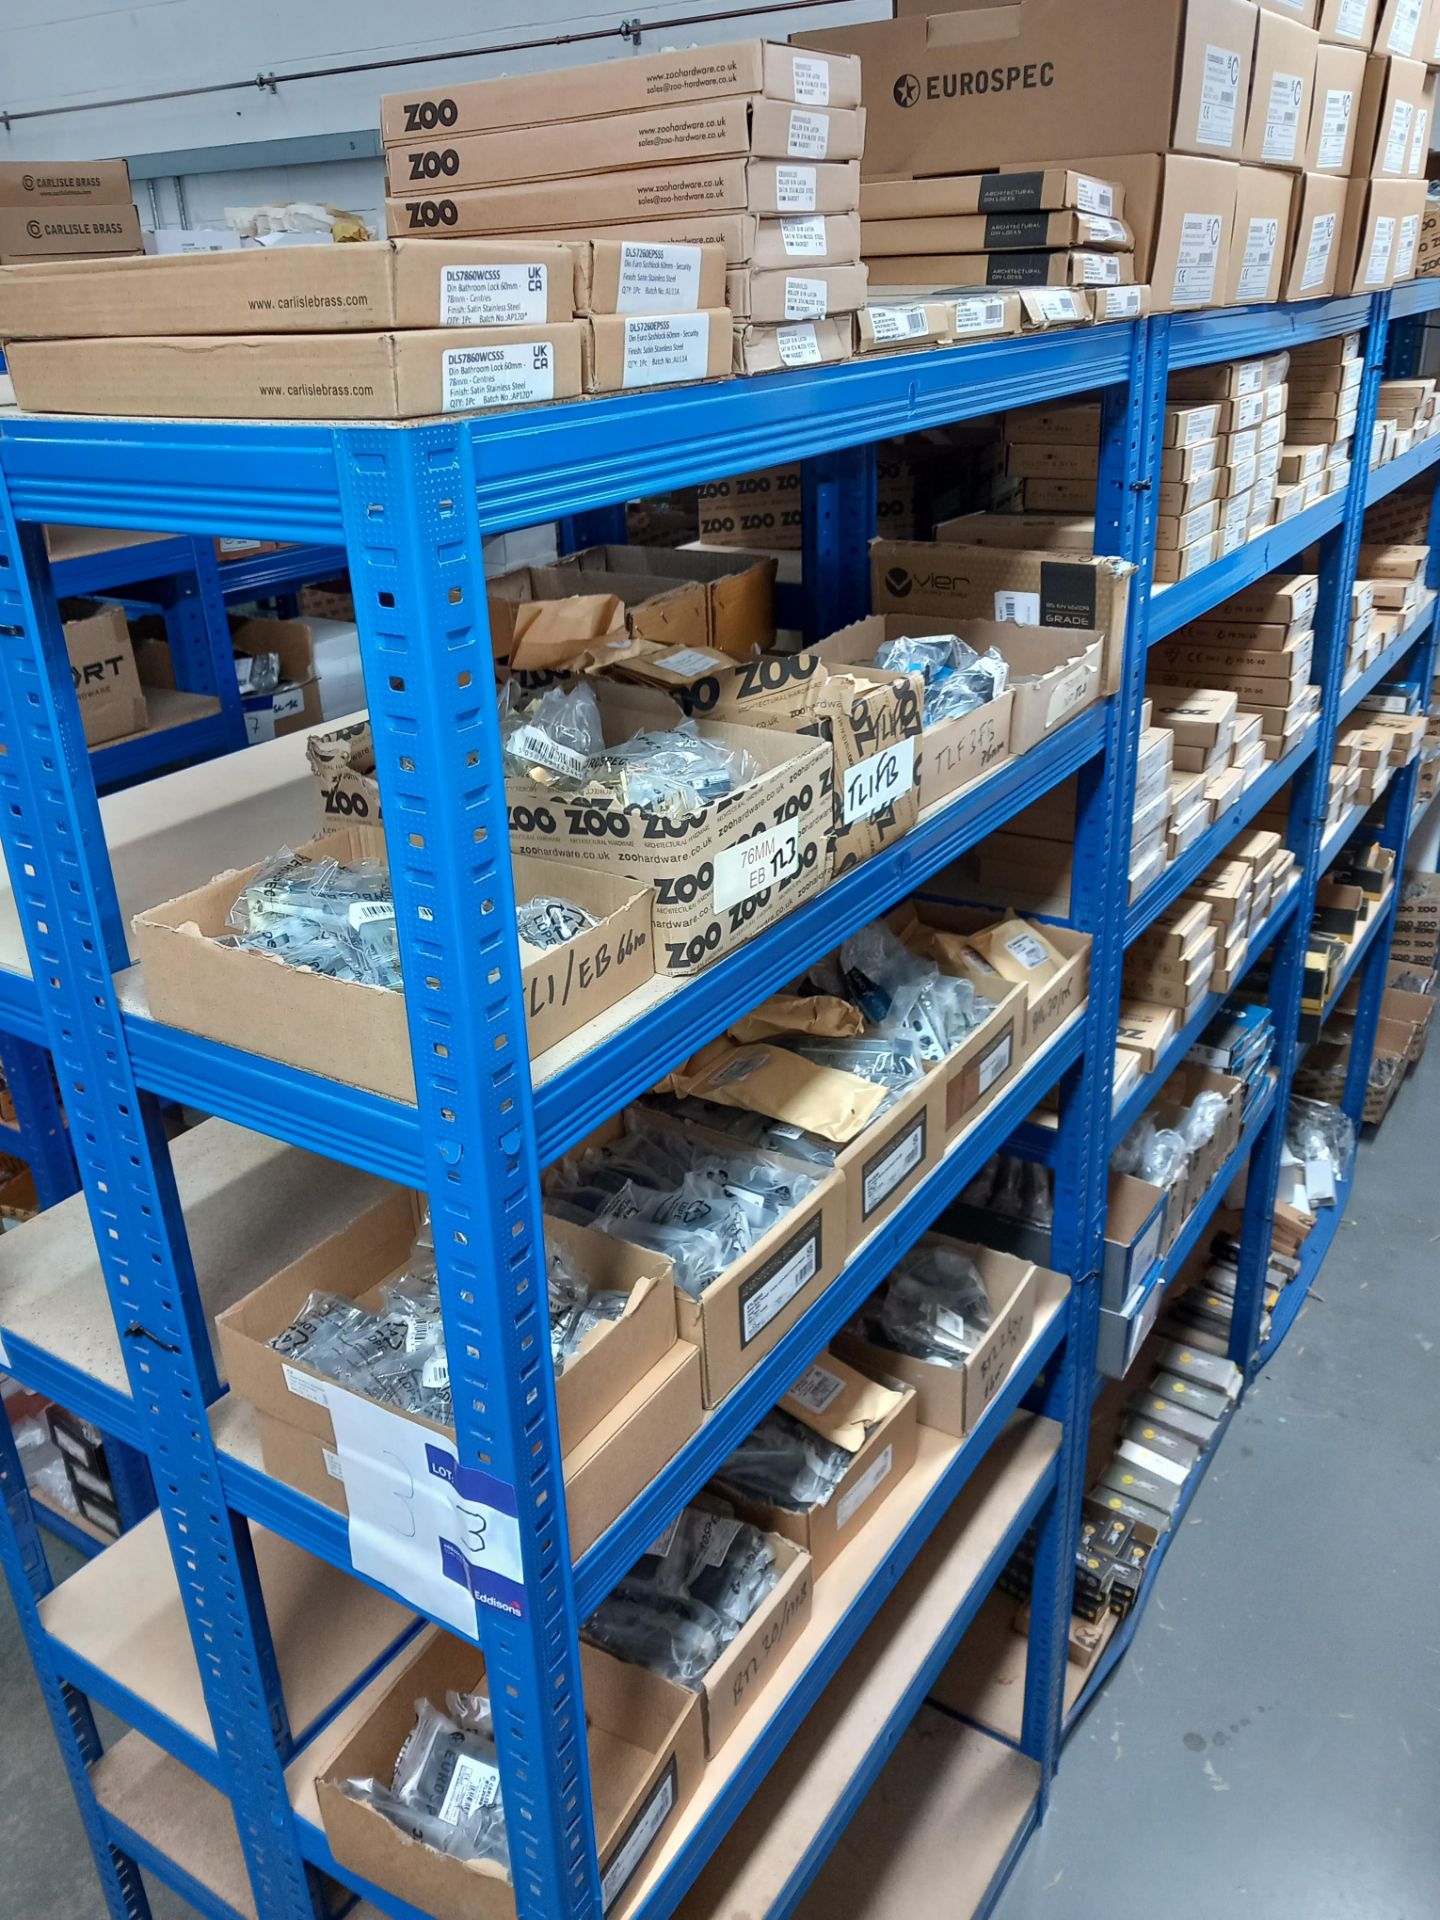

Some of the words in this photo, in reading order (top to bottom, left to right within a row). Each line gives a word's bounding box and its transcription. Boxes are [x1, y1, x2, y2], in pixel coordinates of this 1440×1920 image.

[926, 61, 1055, 100] EUROSPEC
[403, 98, 459, 133] ZOO
[408, 148, 460, 181] ZOO
[36, 178, 75, 188] CARLISLE
[76, 177, 101, 187] BRASS
[984, 189, 1035, 197] ARCHITECTURAL
[405, 199, 459, 229] ZOO
[44, 224, 92, 236] CARLISLE
[93, 223, 123, 234] BRASS
[991, 223, 1041, 231] ARCHITECTURAL
[446, 269, 501, 282] DLS7860WCSSS
[527, 266, 542, 279] UK
[446, 283, 458, 293] Din
[458, 283, 487, 293] Bathroom
[487, 282, 500, 292] Lock
[500, 281, 518, 290] 60mm
[527, 279, 542, 292] CA
[447, 295, 466, 304] 78mm
[469, 294, 492, 302] Centres
[447, 306, 466, 315] Finish:
[467, 305, 482, 314] Satin
[482, 304, 507, 313] Stainless
[507, 303, 521, 311] Steel
[479, 314, 495, 323] Batch
[629, 320, 670, 332] DLS7260EPSSS
[448, 350, 505, 365] DLS7860WCSSS
[532, 345, 548, 357] UK
[448, 367, 459, 376] Din
[460, 365, 490, 375] Bathroom
[490, 363, 504, 372] Lock
[503, 361, 523, 371] 60mm
[533, 357, 548, 370] CA
[449, 378, 468, 387] 78mm
[472, 375, 495, 384] Centres
[450, 387, 469, 397] Finish:
[470, 385, 485, 395] Satin
[486, 382, 511, 393] Stainless
[511, 381, 526, 390] Steel
[449, 399, 464, 409] QTY:
[465, 397, 476, 406] 1Pc
[483, 394, 500, 404] Batch
[736, 477, 771, 495] ZOO
[701, 517, 735, 534] ZOO
[740, 511, 774, 529] ZOO
[913, 571, 971, 590] vier
[1045, 613, 1089, 626] GRADE
[735, 653, 821, 700] ZOO
[320, 789, 369, 818] ZOO
[718, 783, 785, 838] zoohardware.co.uk
[564, 808, 630, 838] ZOO
[519, 845, 610, 861] zoohardware.co.uk
[618, 836, 713, 865] zoohardware.co.uk
[740, 836, 776, 869] 76MM
[770, 836, 797, 878] TL3
[653, 861, 714, 905] ZOO
[749, 866, 766, 889] EB
[728, 886, 772, 933] ZOO
[665, 921, 722, 969] ZOO
[431, 1463, 455, 1484] LOT:
[474, 1589, 523, 1618] Eddisons
